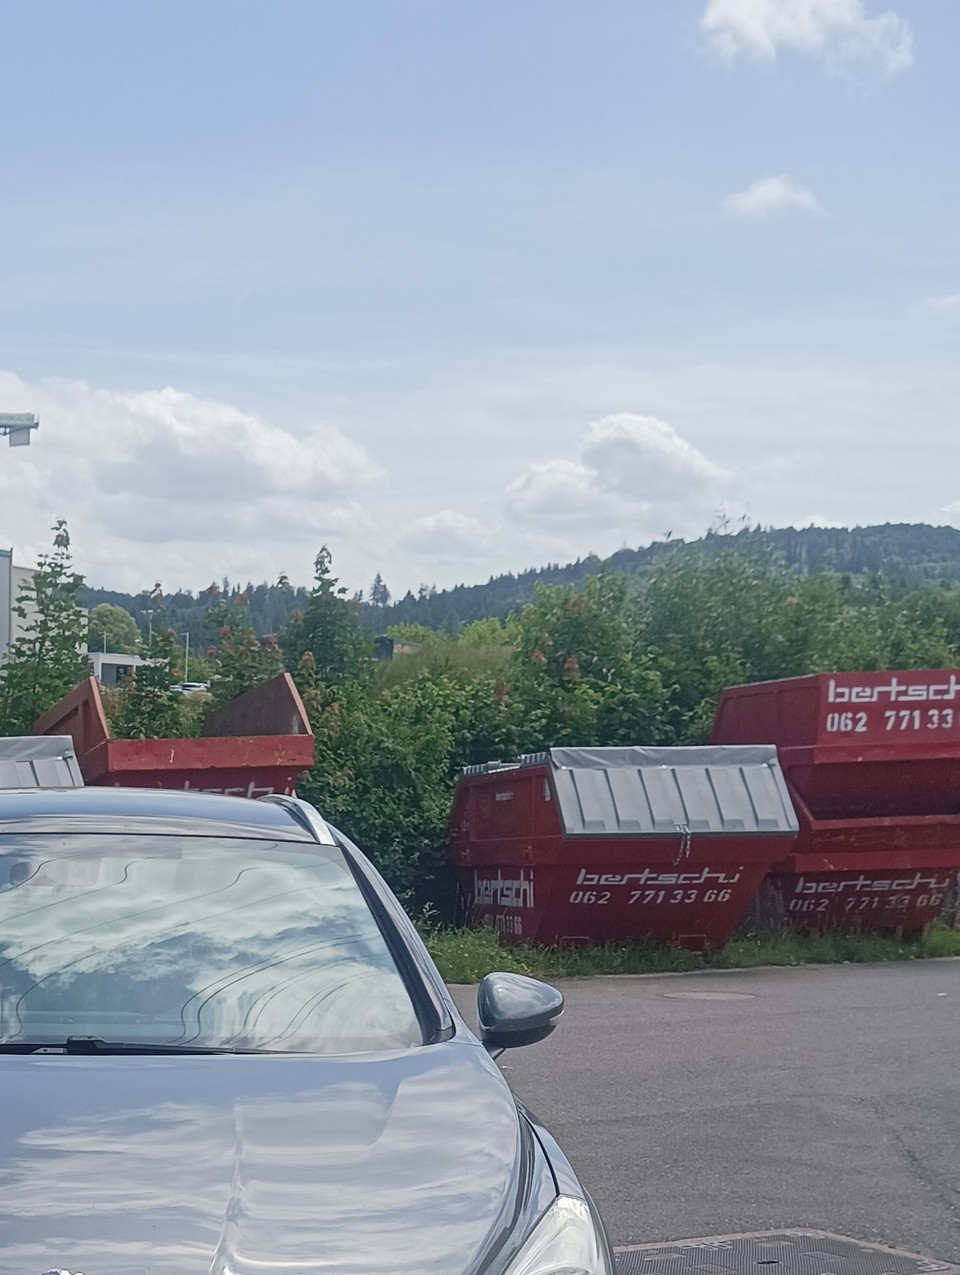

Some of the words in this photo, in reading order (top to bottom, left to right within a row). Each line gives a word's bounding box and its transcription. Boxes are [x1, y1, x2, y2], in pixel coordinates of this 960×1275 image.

[826, 711, 868, 732] 062
[884, 709, 921, 731] 771
[927, 708, 954, 729] 33
[576, 866, 744, 886] bertschi
[475, 868, 534, 908] bertschi
[569, 890, 612, 905] 062
[627, 890, 666, 905] 771
[669, 889, 697, 904] 33
[703, 888, 734, 903] 66
[789, 899, 830, 912] 062
